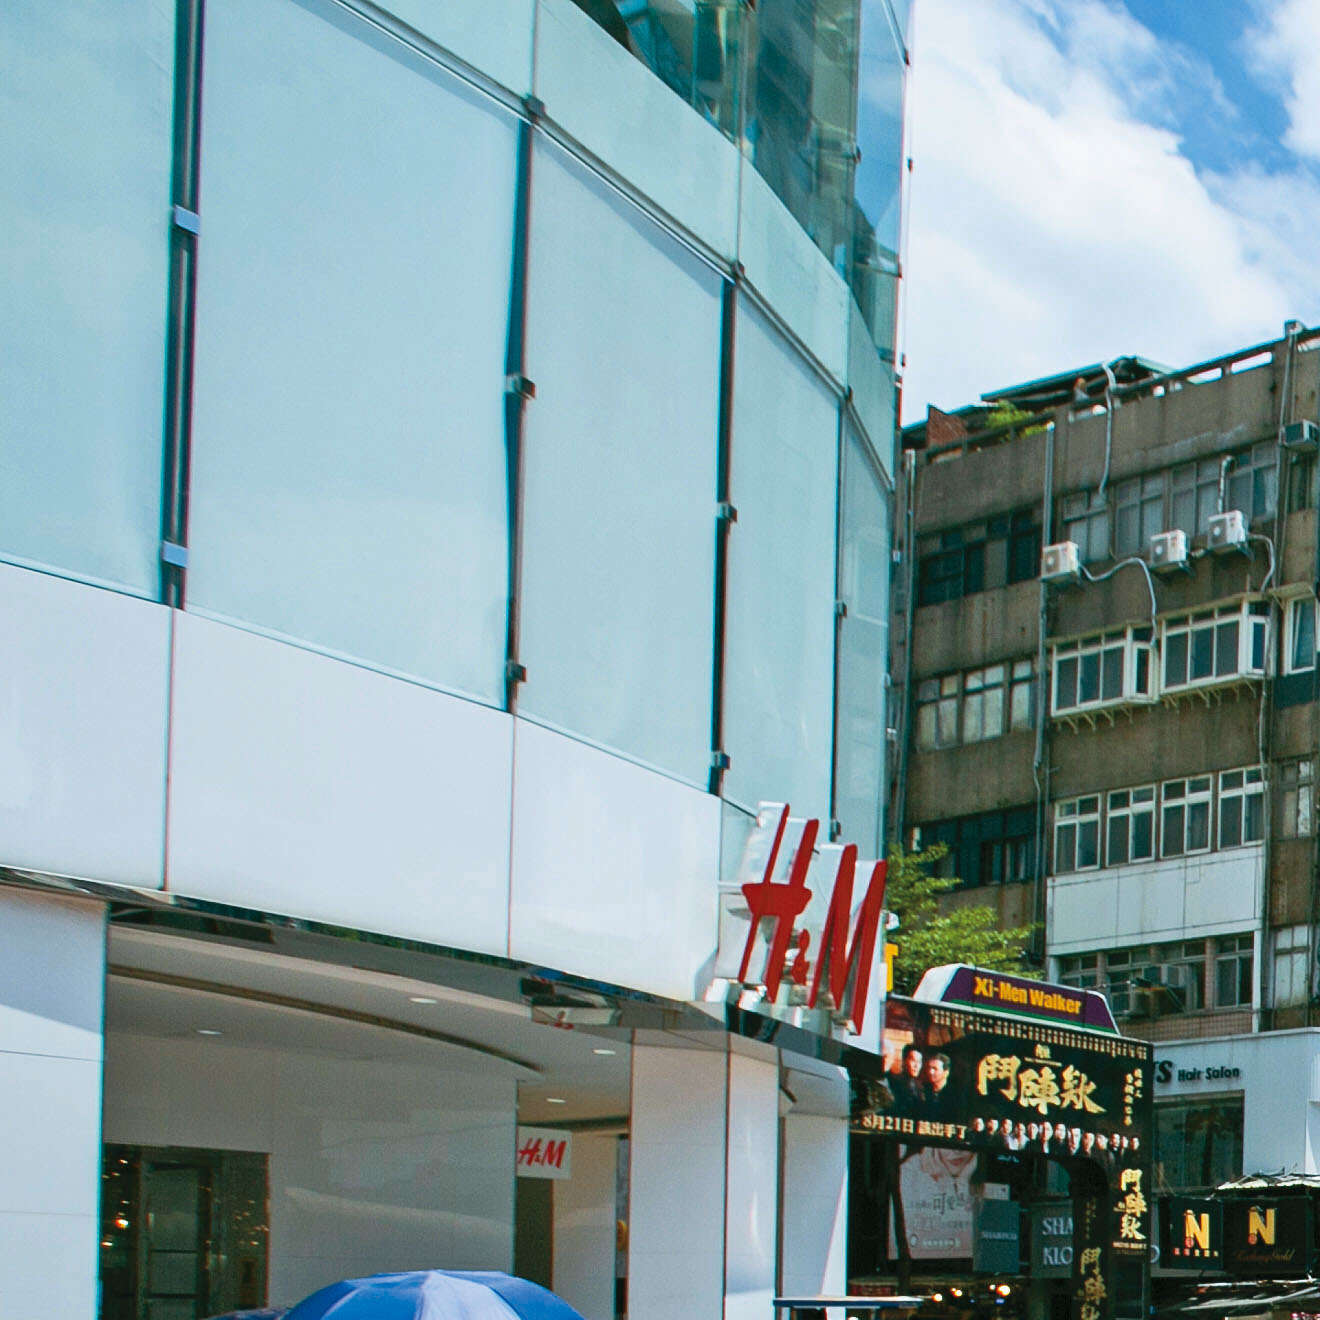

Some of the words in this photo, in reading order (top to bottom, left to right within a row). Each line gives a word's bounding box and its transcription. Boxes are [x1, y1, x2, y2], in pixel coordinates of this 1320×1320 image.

[737, 803, 888, 1036] H&M
[973, 975, 1028, 1004] Xi-Men
[1030, 988, 1082, 1016] Walker
[1152, 1060, 1173, 1083] S
[1178, 1069, 1202, 1082] Hair
[1205, 1065, 1241, 1081] Salon
[518, 1138, 568, 1168] H&M
[1184, 1211, 1210, 1250] N
[1249, 1207, 1276, 1246] N
